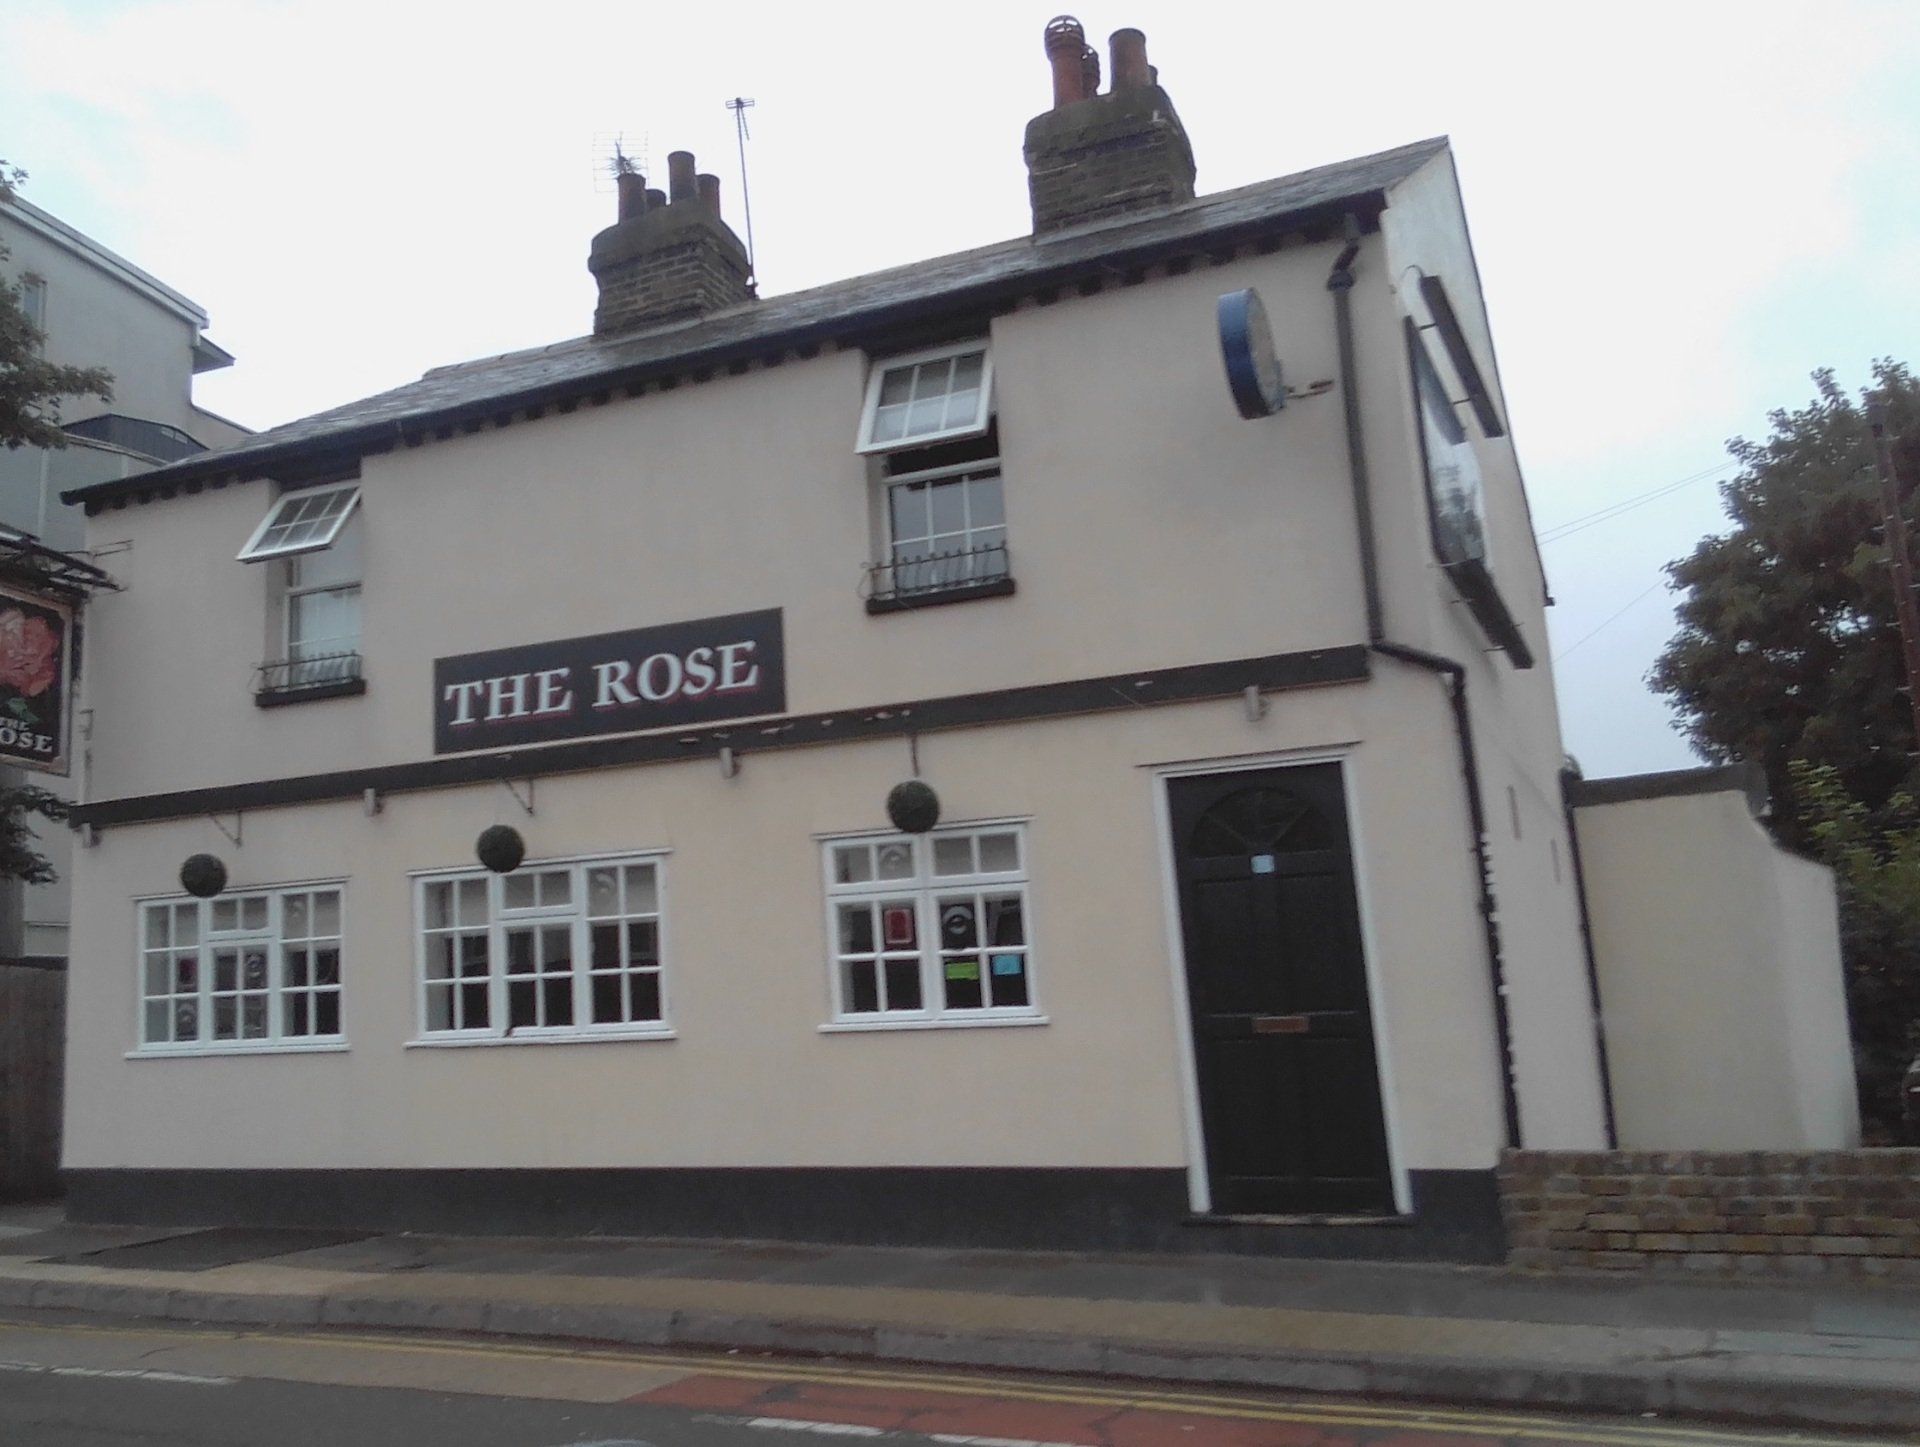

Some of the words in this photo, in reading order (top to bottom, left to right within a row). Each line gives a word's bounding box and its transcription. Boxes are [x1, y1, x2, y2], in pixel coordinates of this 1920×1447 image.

[444, 667, 574, 727] THE
[592, 640, 760, 708] ROSE
[0, 727, 53, 752] OSE
